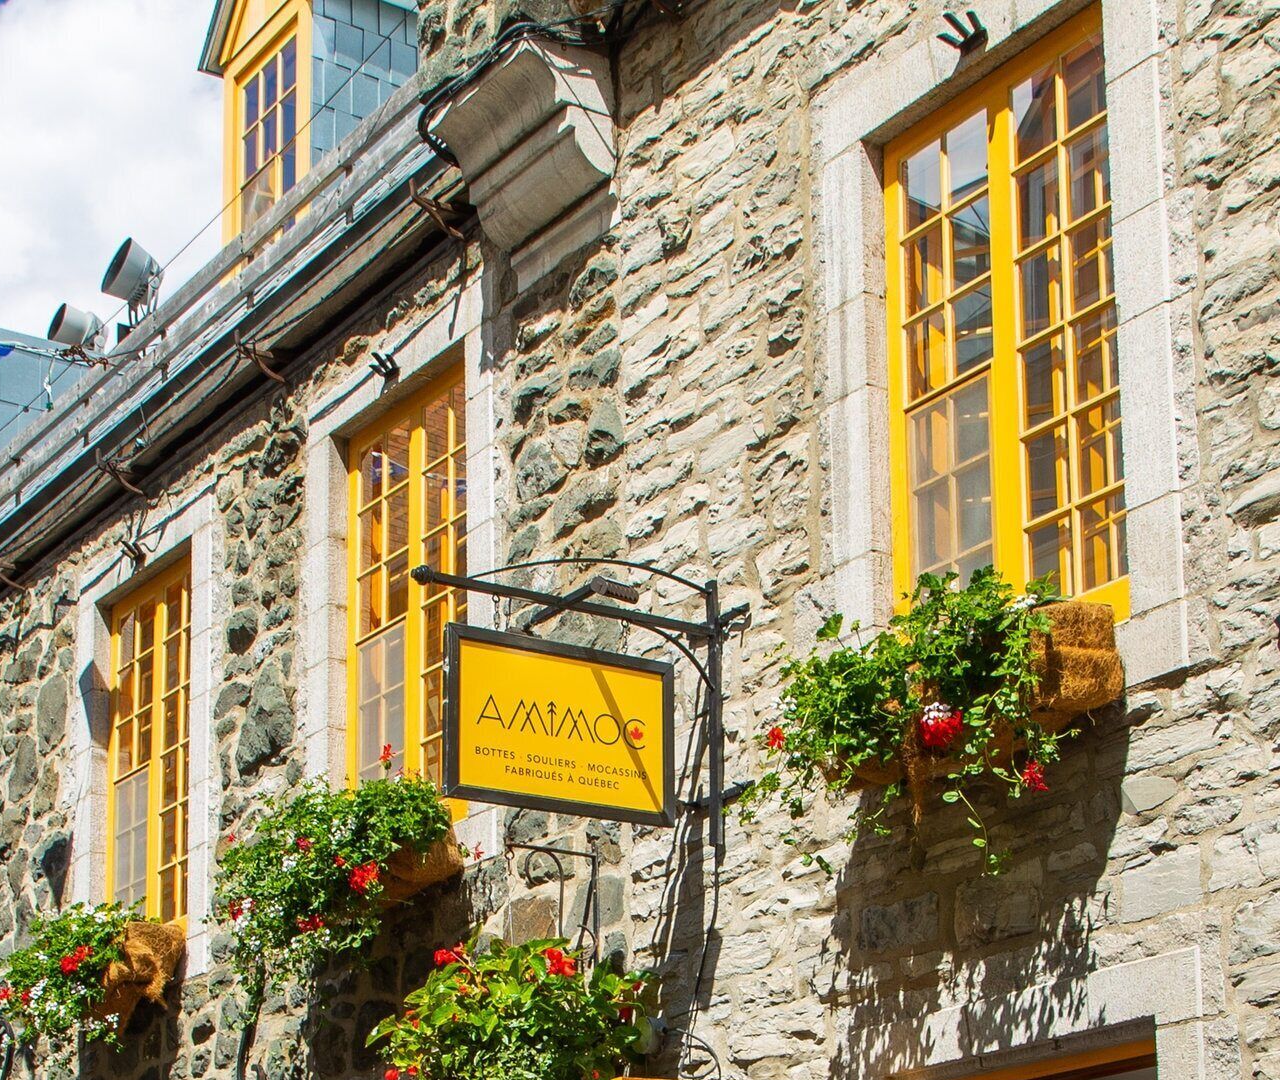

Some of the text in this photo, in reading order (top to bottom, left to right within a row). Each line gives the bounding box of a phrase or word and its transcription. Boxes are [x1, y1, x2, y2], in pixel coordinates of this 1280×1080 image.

[476, 693, 646, 750] AMIMOC
[475, 746, 647, 781] BOTTES SOULIERS MOCASSINS
[505, 765, 563, 782] FABRIQUÉS
[578, 775, 620, 790] QUÉBEC
